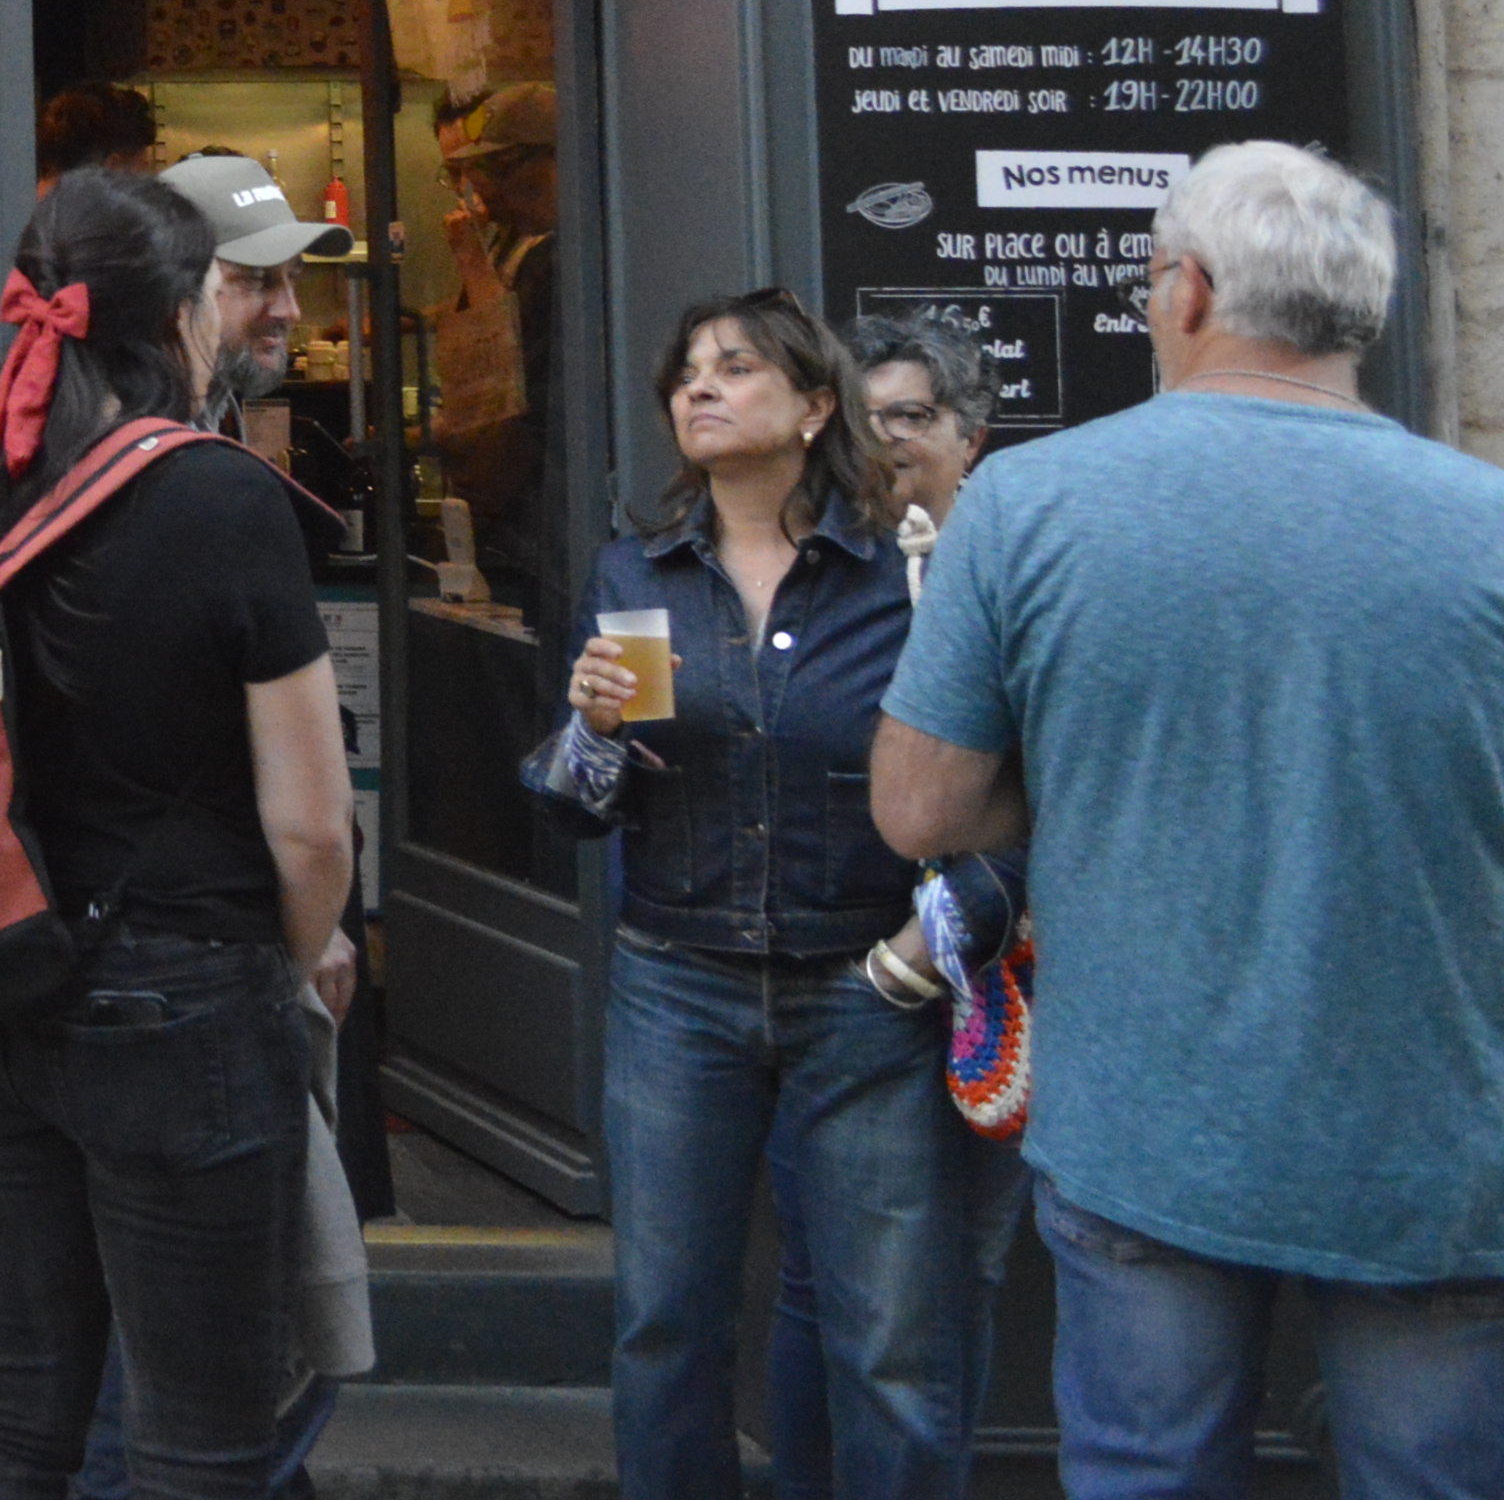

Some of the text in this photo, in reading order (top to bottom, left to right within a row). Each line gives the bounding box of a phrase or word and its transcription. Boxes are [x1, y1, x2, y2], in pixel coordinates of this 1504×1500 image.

[1101, 36, 1154, 66] 12H
[908, 89, 932, 112] et
[1002, 164, 1170, 190] Nos menus
[1095, 228, 1110, 259] à
